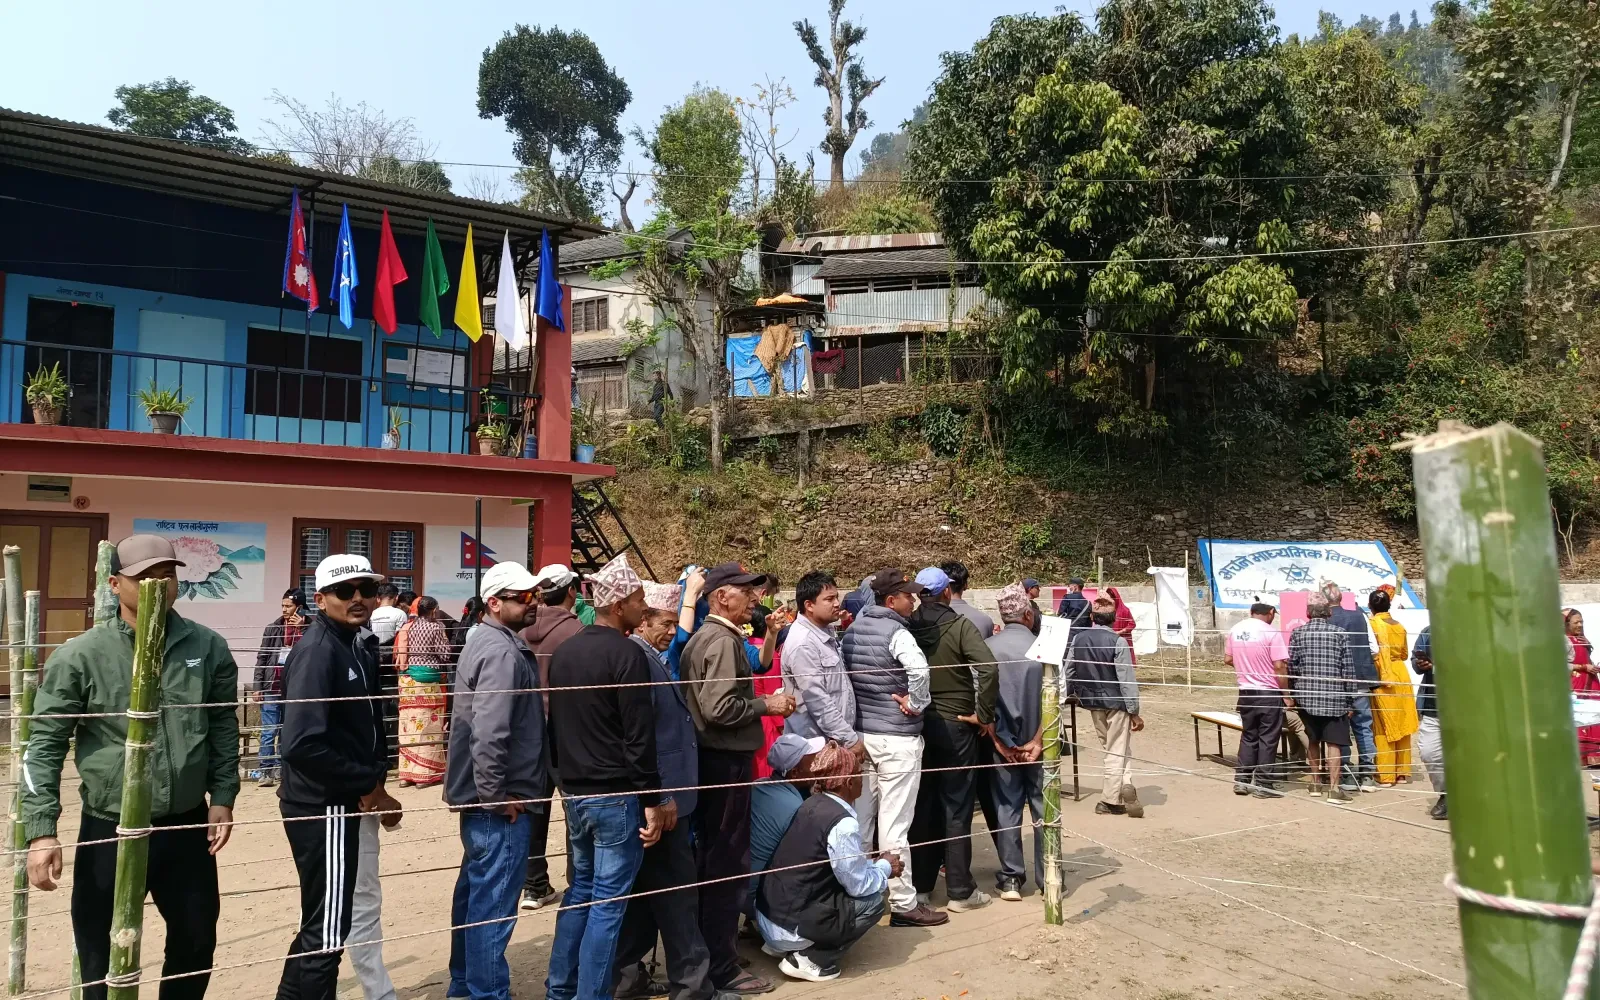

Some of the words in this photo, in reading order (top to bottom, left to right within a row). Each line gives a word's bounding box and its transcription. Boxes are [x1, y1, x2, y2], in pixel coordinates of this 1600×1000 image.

[328, 564, 358, 578] ZORBAZ
[1248, 545, 1323, 563] माध्यमिक
[1324, 548, 1393, 579] विद्यालय
